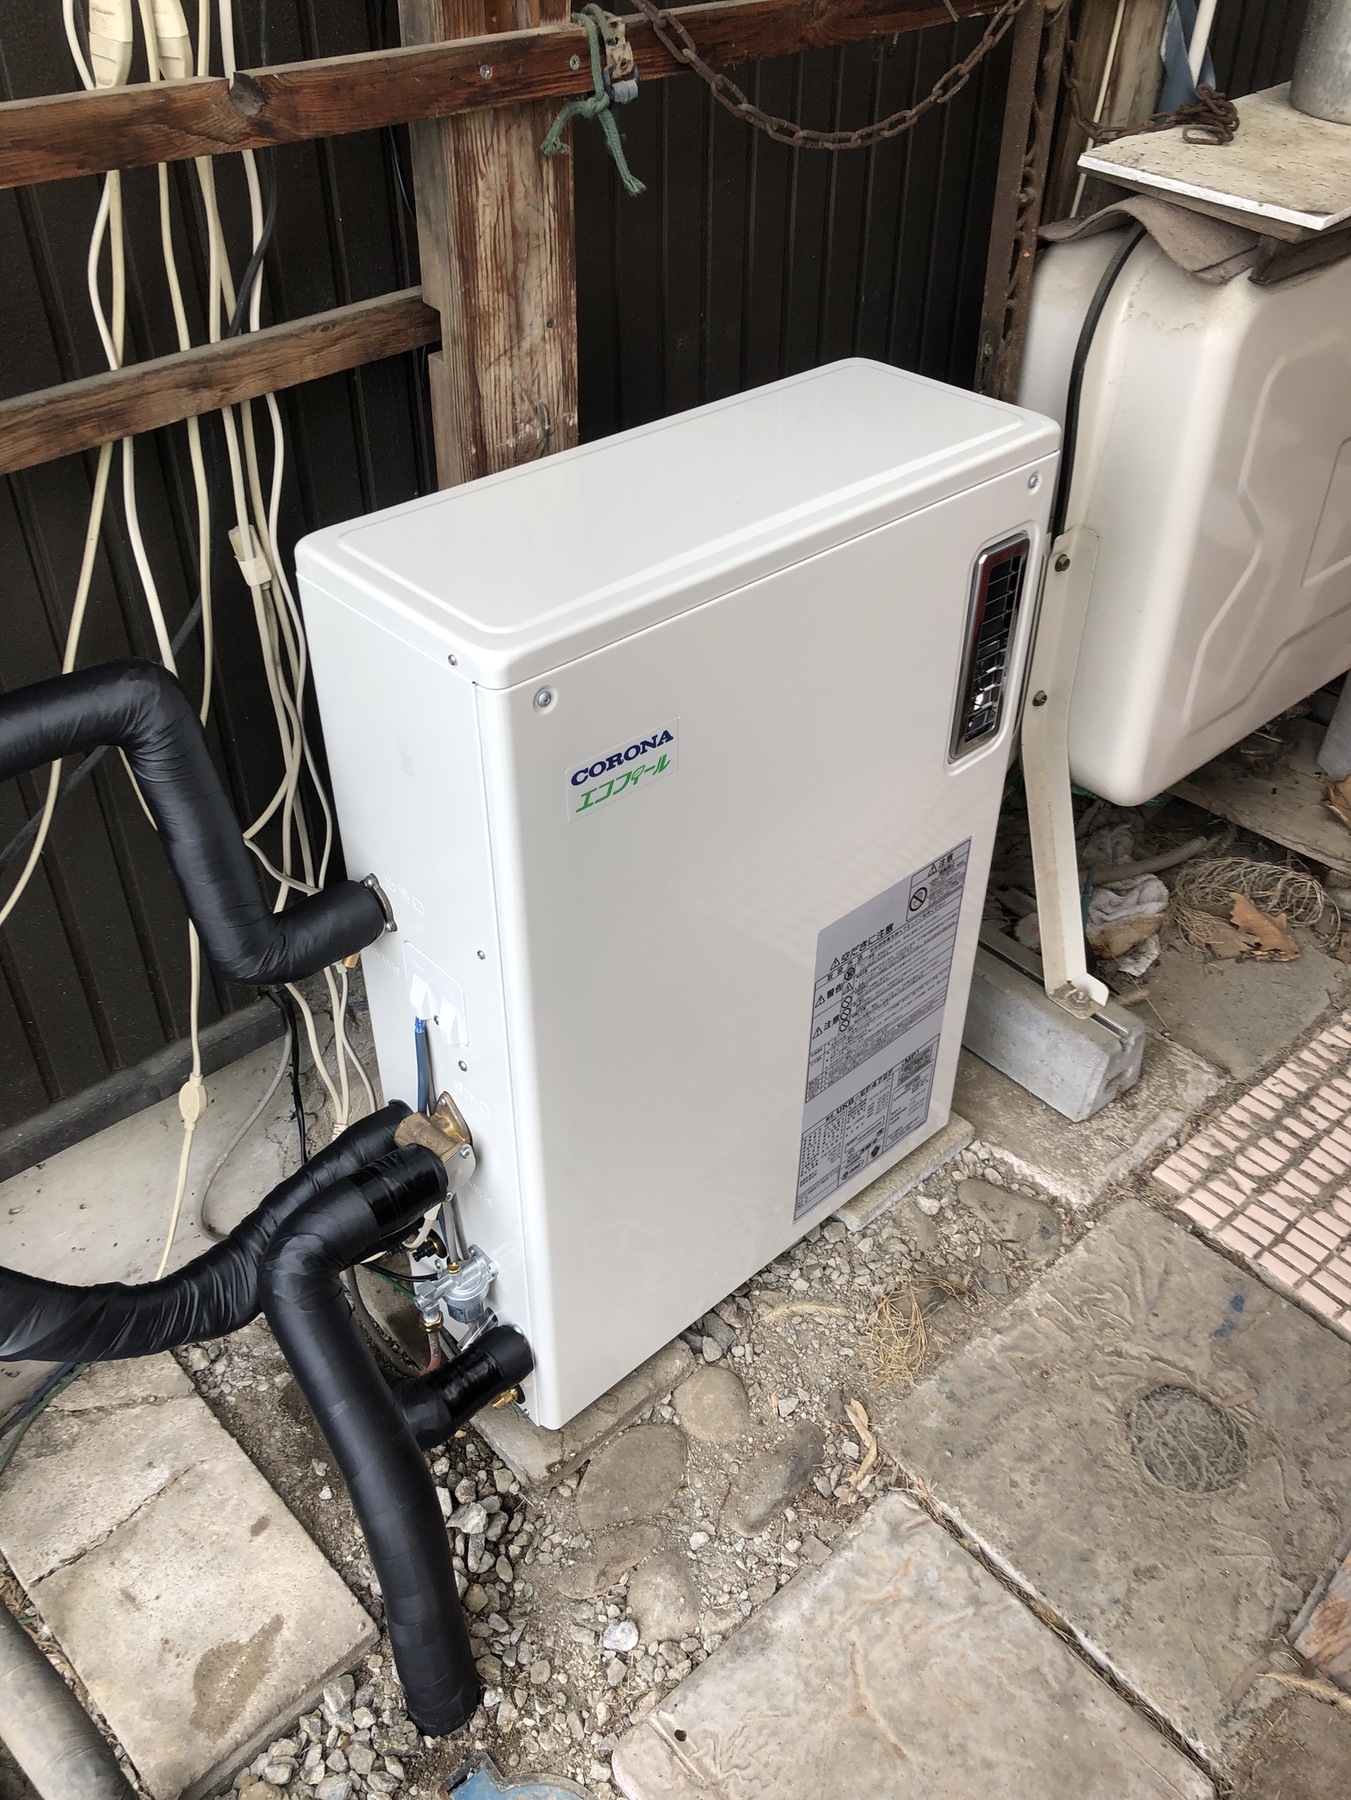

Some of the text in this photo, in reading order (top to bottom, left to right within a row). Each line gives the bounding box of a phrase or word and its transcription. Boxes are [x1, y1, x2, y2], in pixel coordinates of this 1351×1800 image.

[571, 729, 674, 787] CORONA
[575, 753, 671, 813] エコフィール
[841, 922, 894, 962] 空だきに注意
